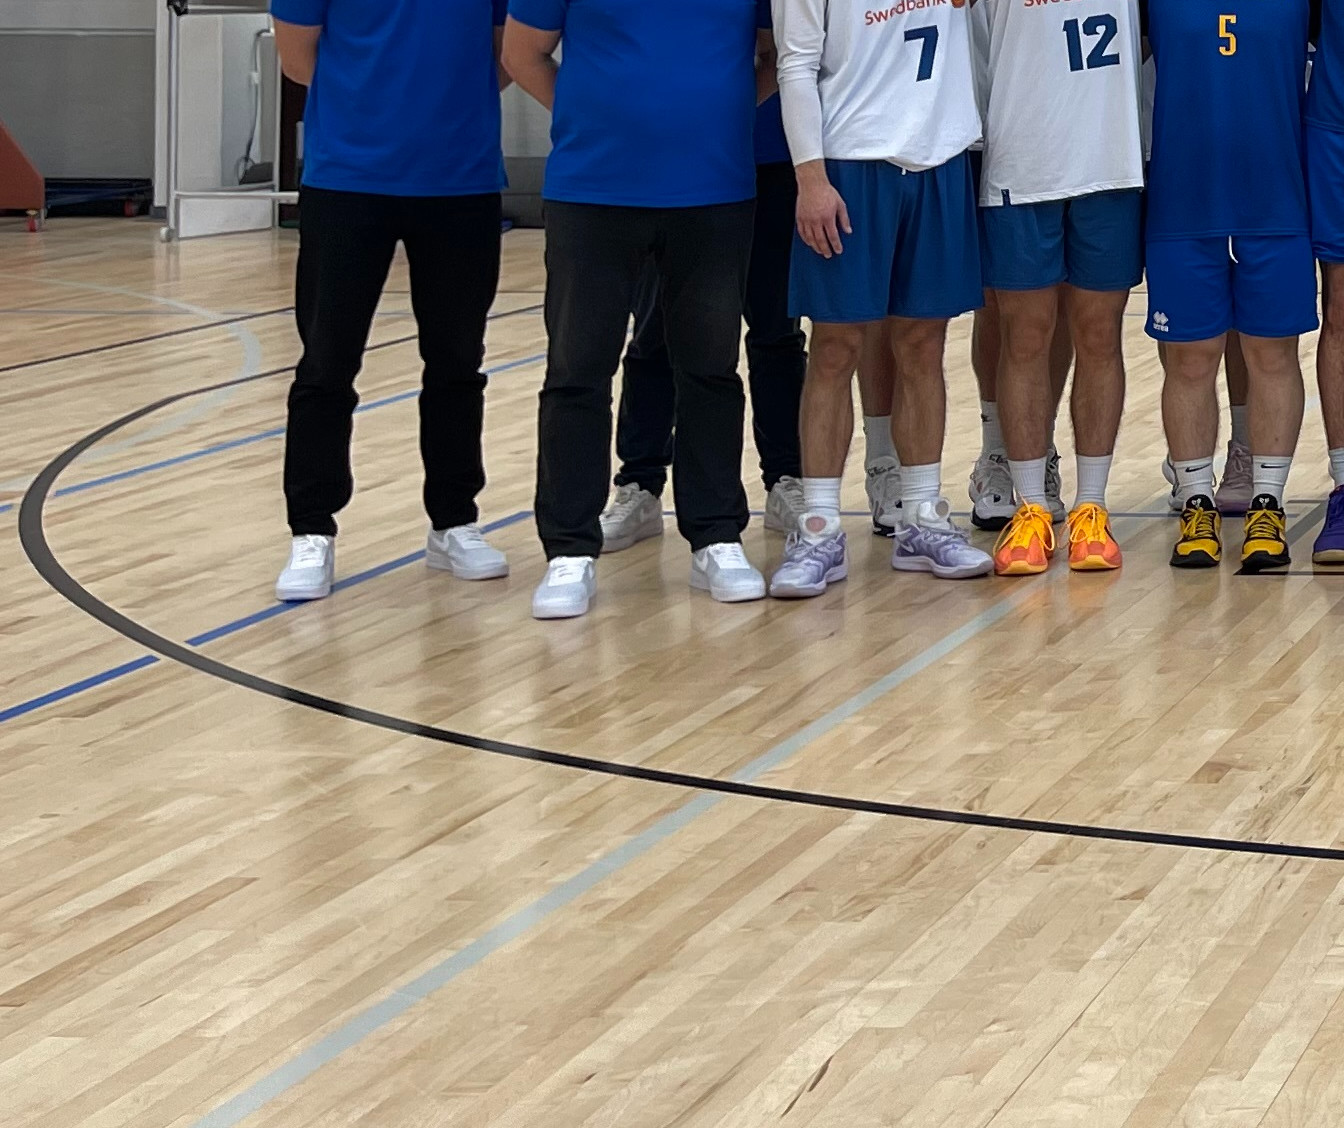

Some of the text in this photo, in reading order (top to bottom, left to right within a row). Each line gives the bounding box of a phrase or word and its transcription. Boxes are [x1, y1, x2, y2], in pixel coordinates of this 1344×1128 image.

[904, 25, 939, 82] 7
[1062, 13, 1120, 72] 12
[1218, 14, 1237, 56] 5
